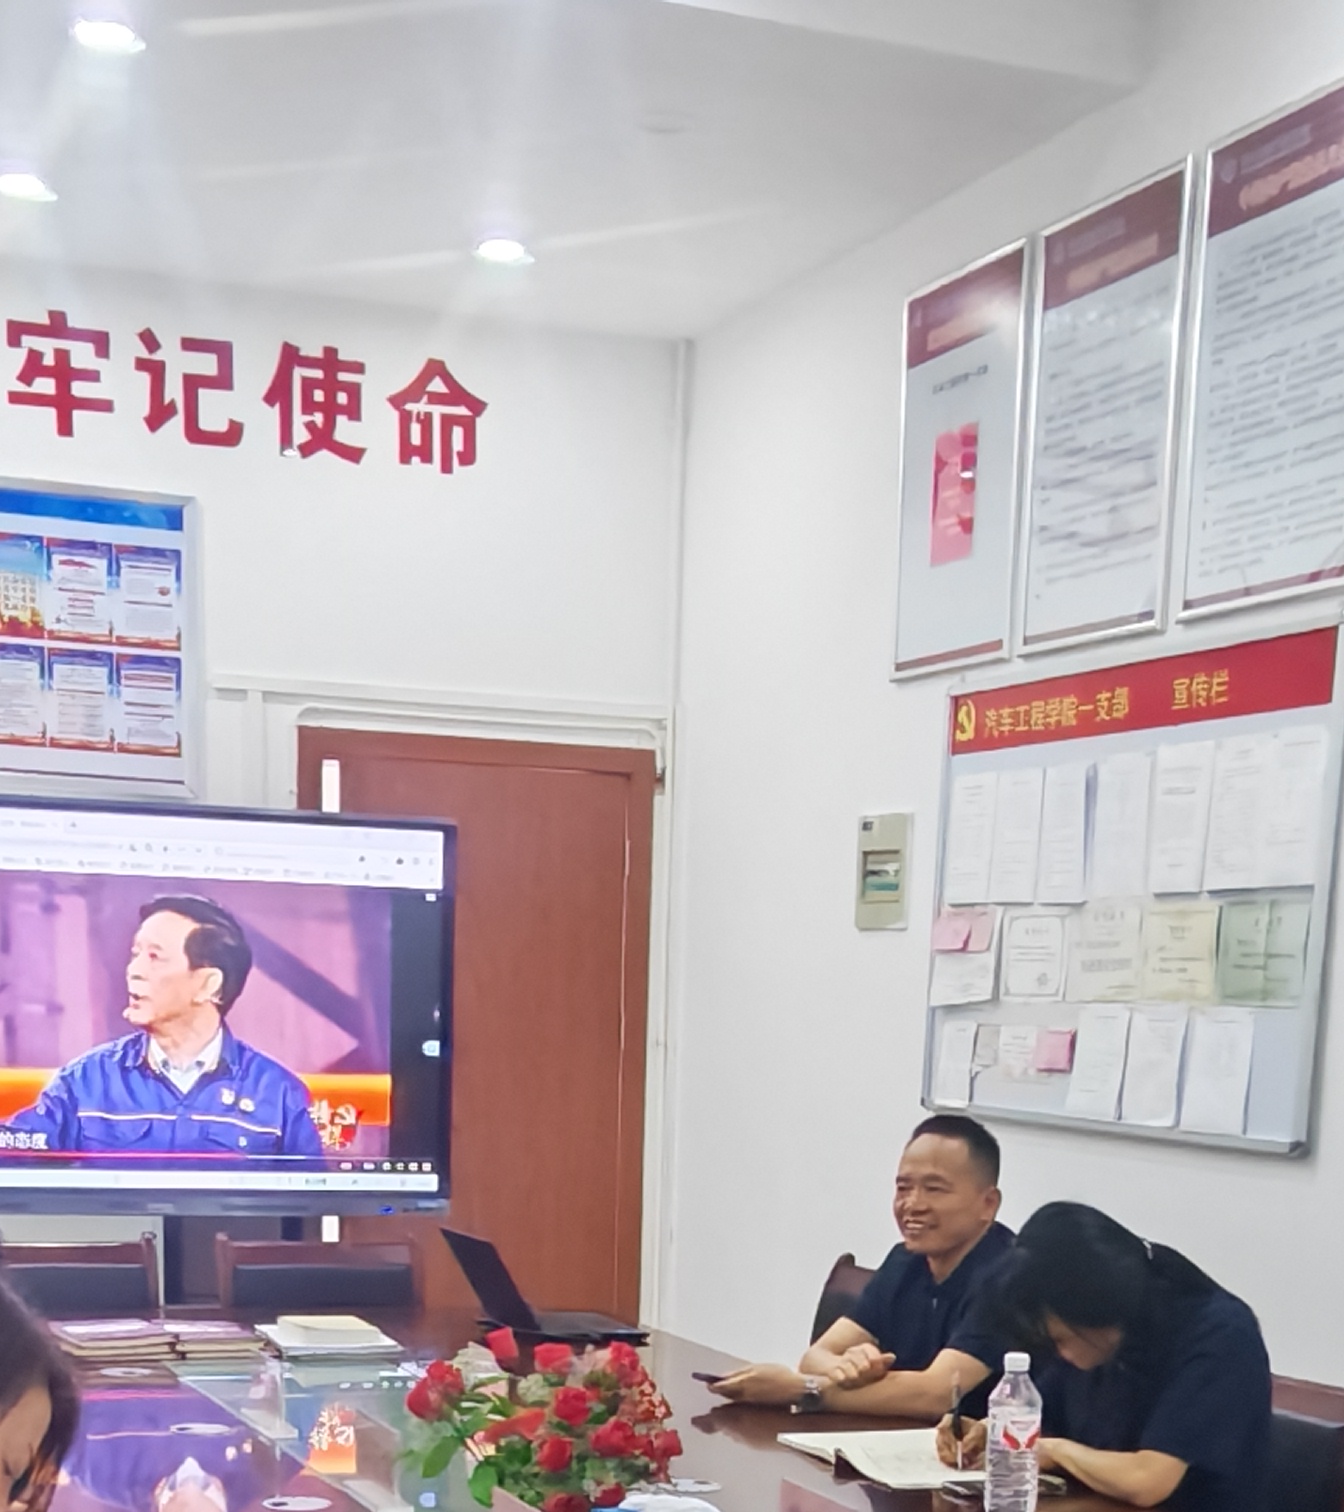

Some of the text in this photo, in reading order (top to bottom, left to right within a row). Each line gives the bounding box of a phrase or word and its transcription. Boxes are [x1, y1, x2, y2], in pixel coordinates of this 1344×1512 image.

[6, 309, 489, 475] 牢记使命
[1171, 668, 1229, 710] 宣传栏
